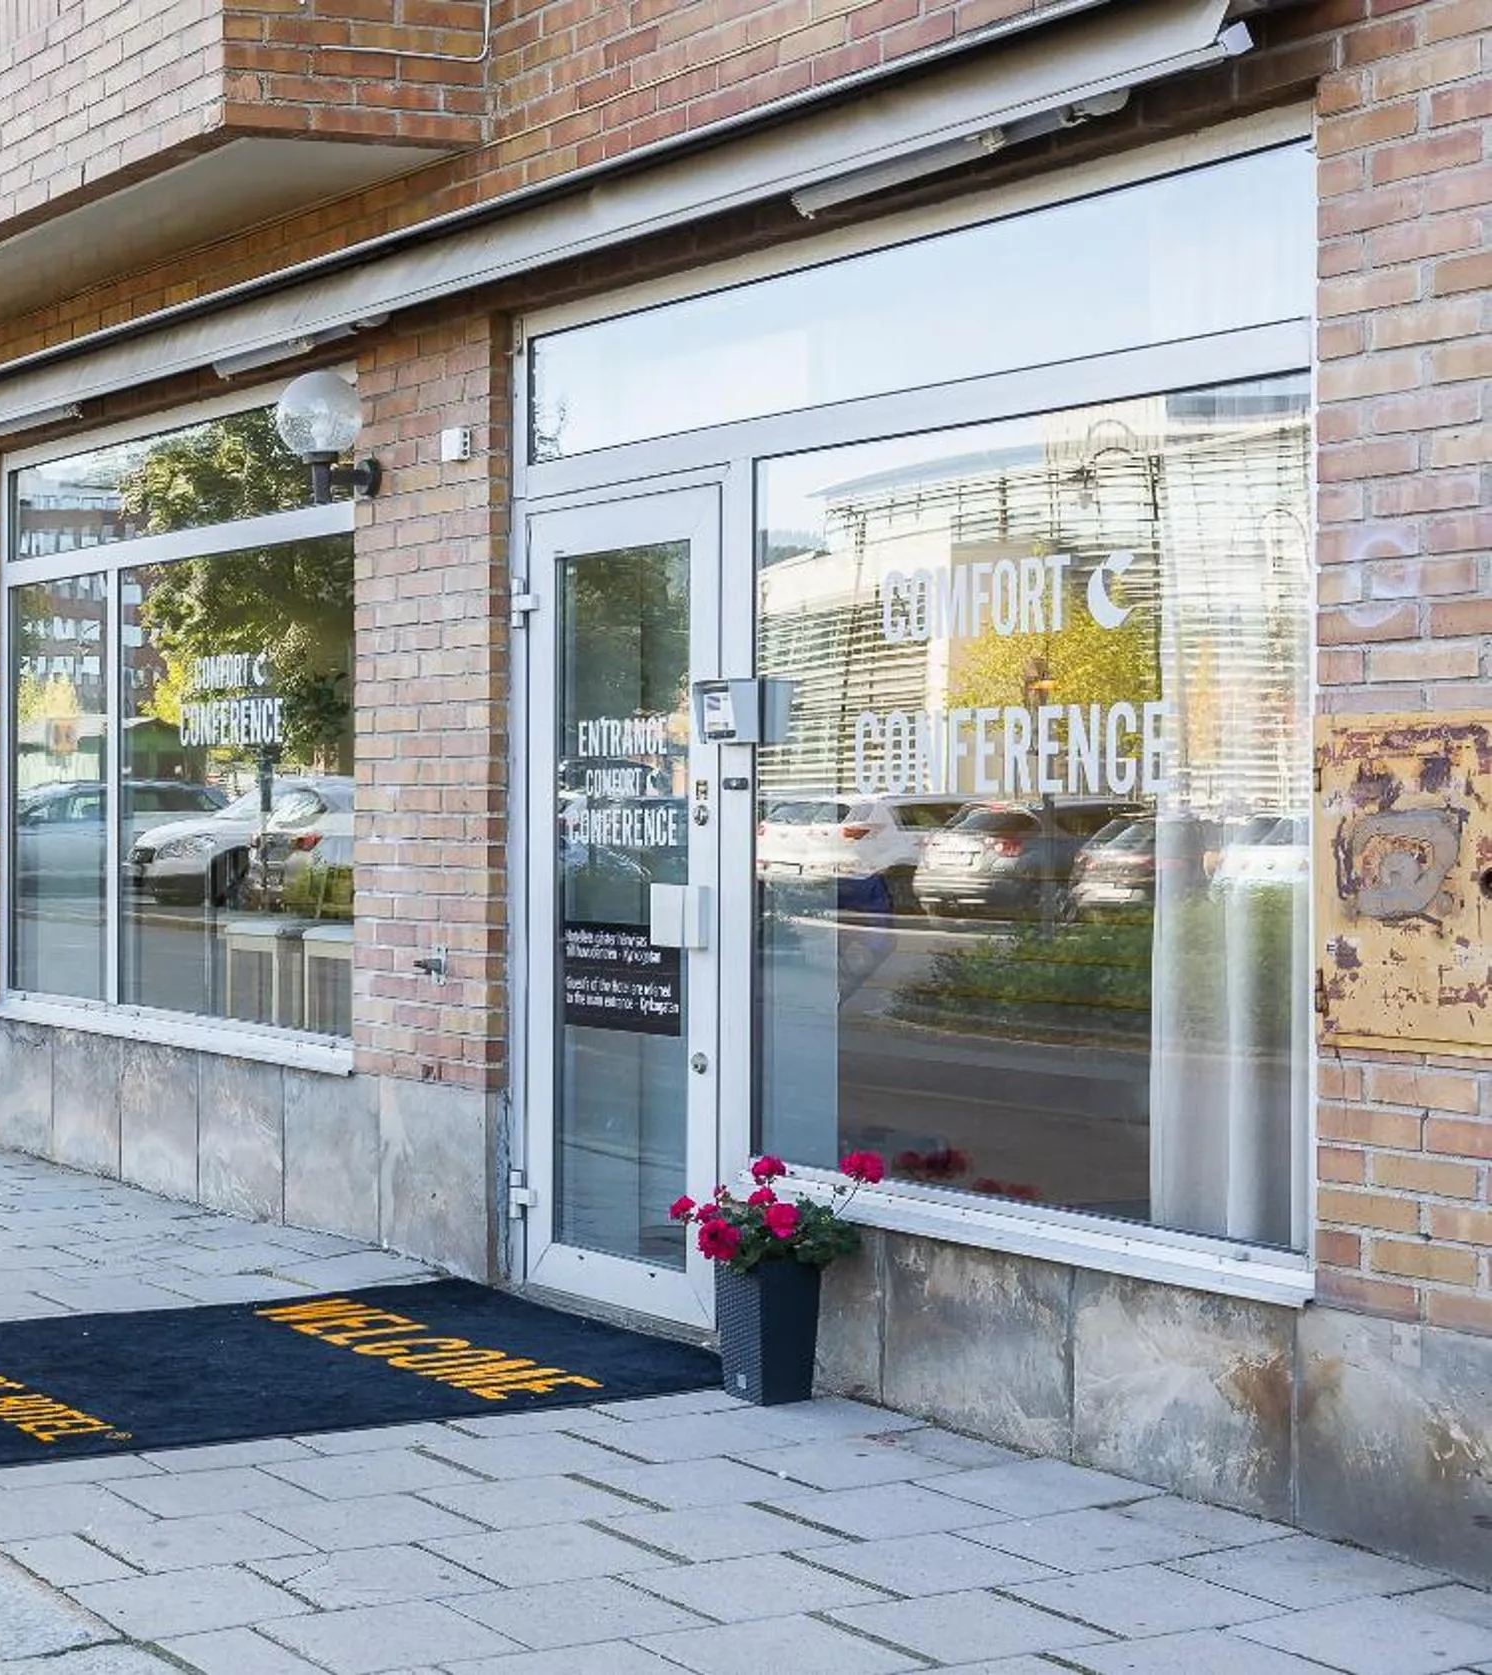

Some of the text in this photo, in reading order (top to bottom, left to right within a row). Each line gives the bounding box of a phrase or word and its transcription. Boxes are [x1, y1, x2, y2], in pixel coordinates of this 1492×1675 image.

[882, 554, 1071, 643] COMFORT
[194, 652, 250, 691] COMFORT
[179, 698, 284, 747] CONFERENCE
[578, 717, 668, 757] ENTRANCE
[854, 701, 1176, 796] CONFERENCE
[586, 767, 642, 799] COMFORT
[570, 808, 678, 847] CONFERENCE
[252, 1298, 603, 1400] WELCOME
